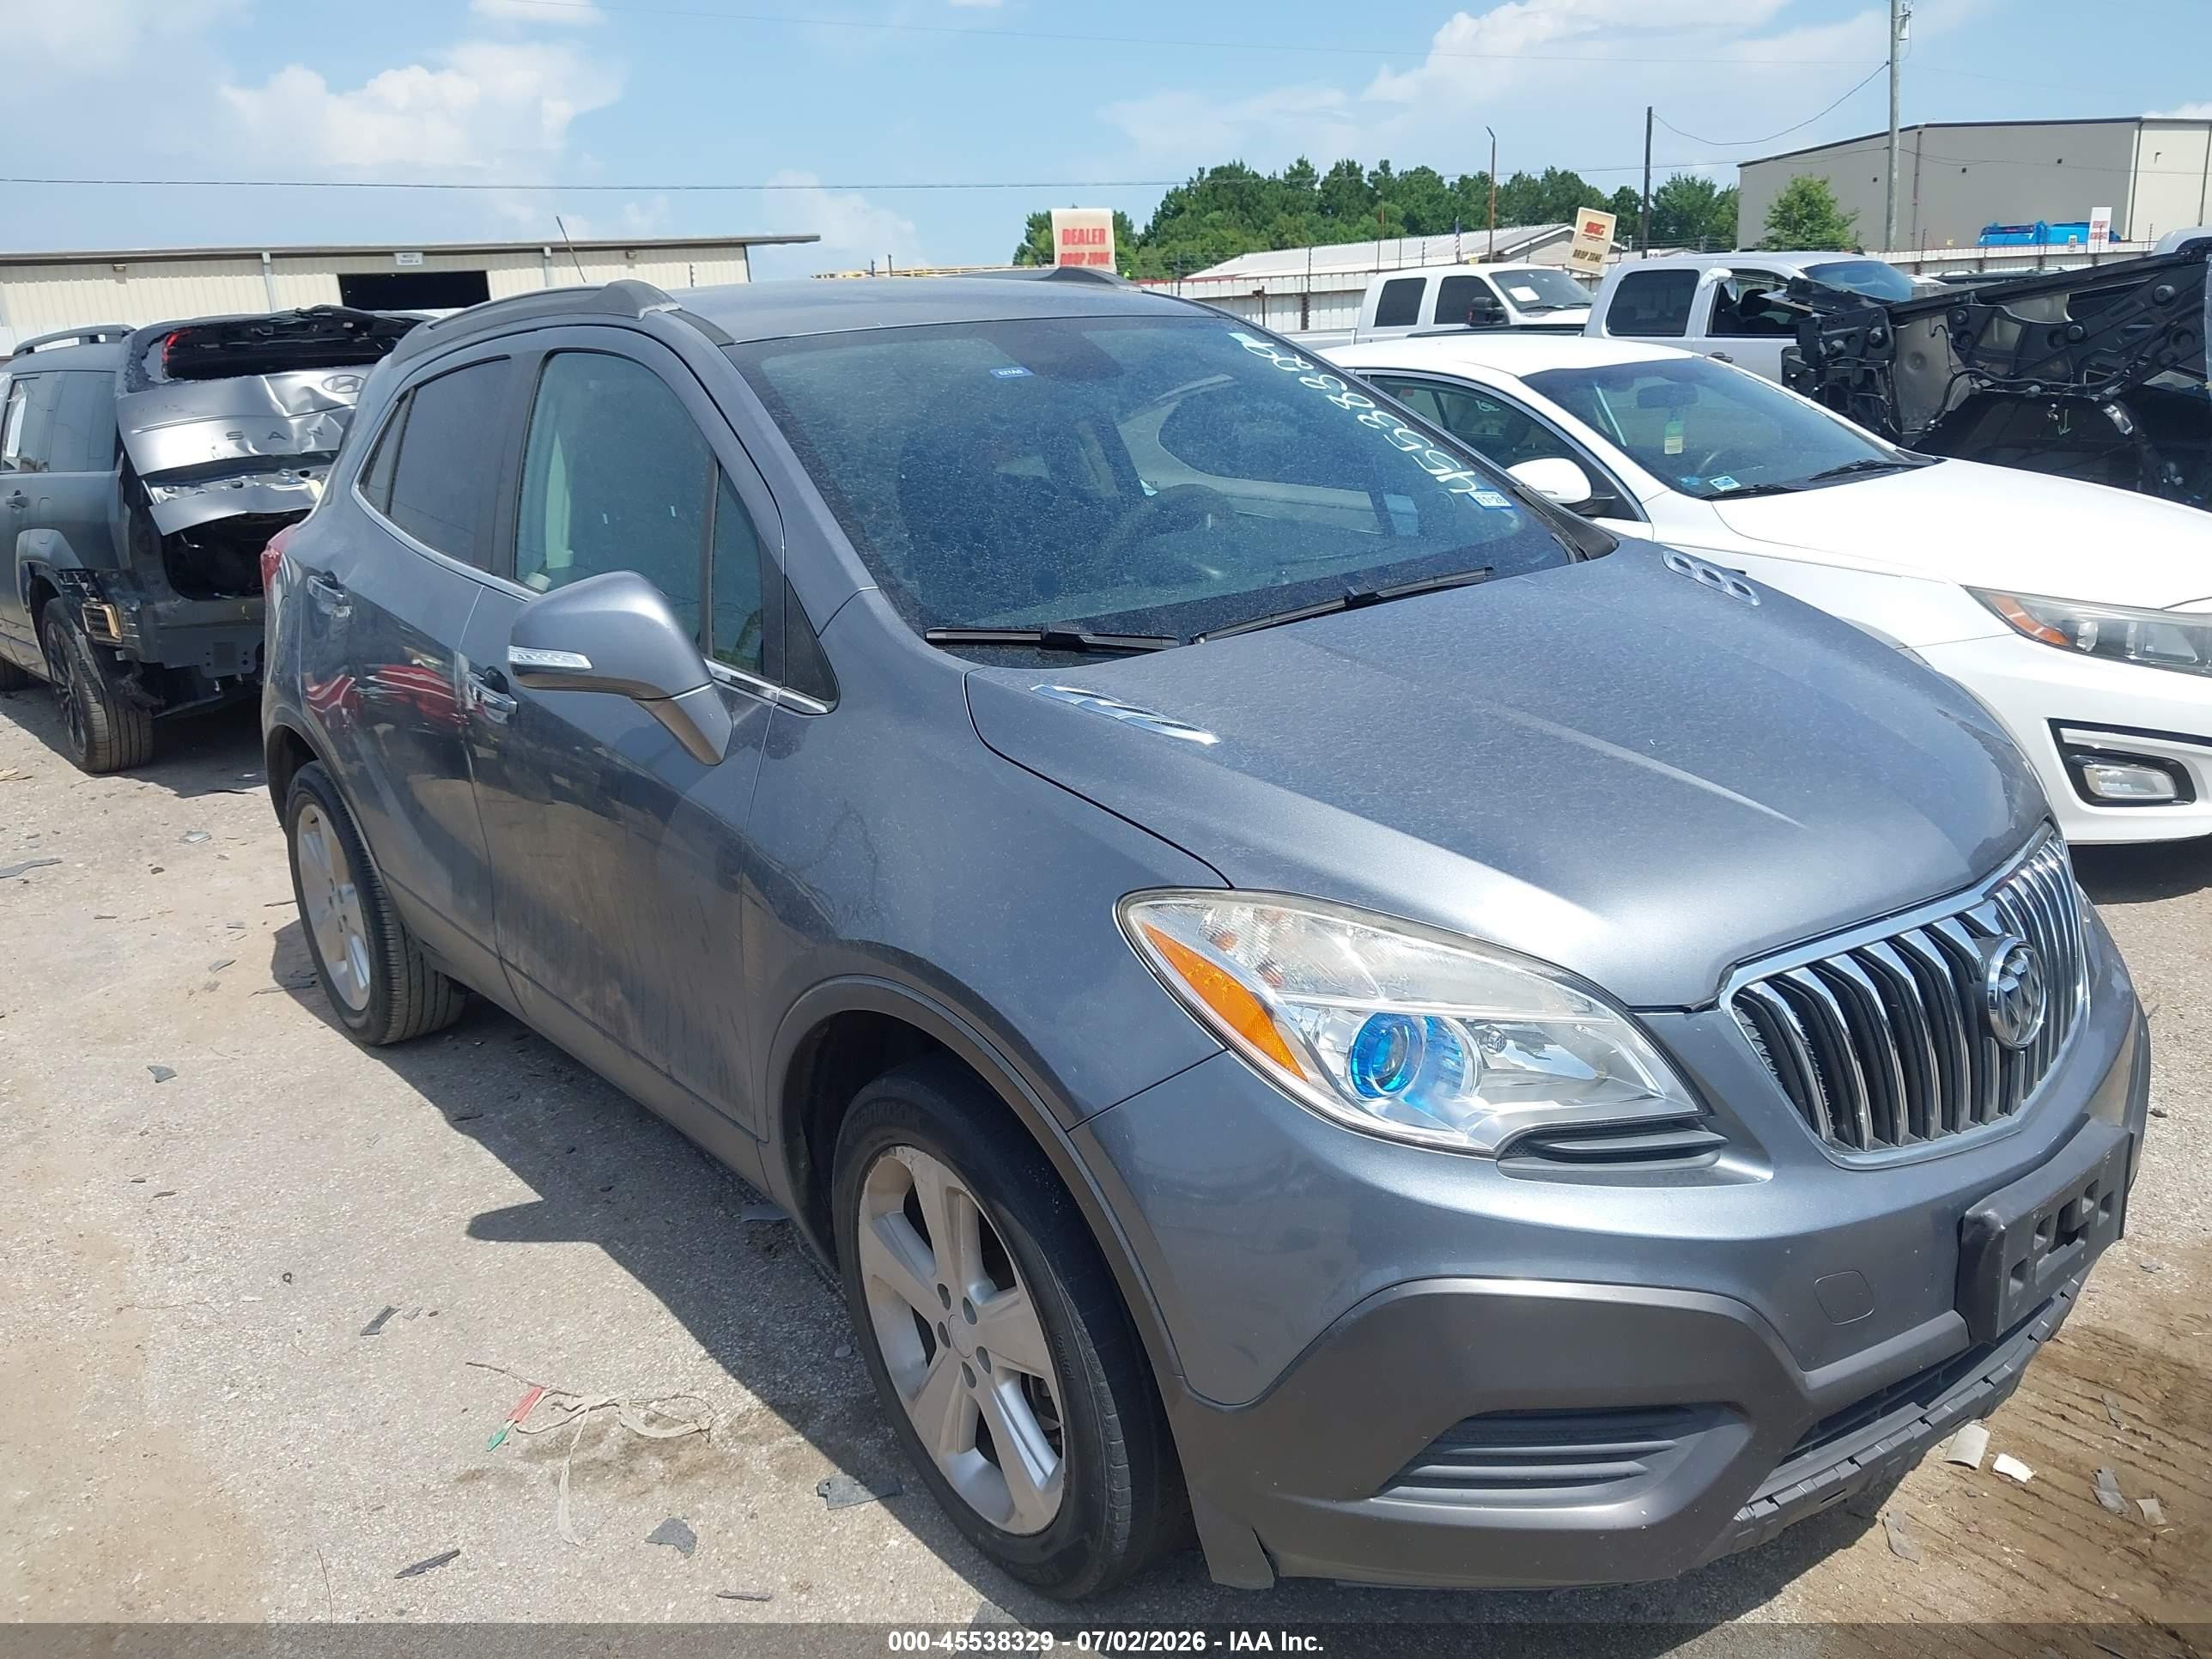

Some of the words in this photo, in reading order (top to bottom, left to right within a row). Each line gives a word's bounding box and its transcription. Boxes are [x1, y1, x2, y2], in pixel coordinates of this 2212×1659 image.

[1062, 228, 1106, 246] DEALER
[1088, 252, 1110, 264] ZONE
[1572, 249, 1589, 259] DROP
[1587, 252, 1603, 263] ZONE
[1227, 332, 1477, 494] 45538329
